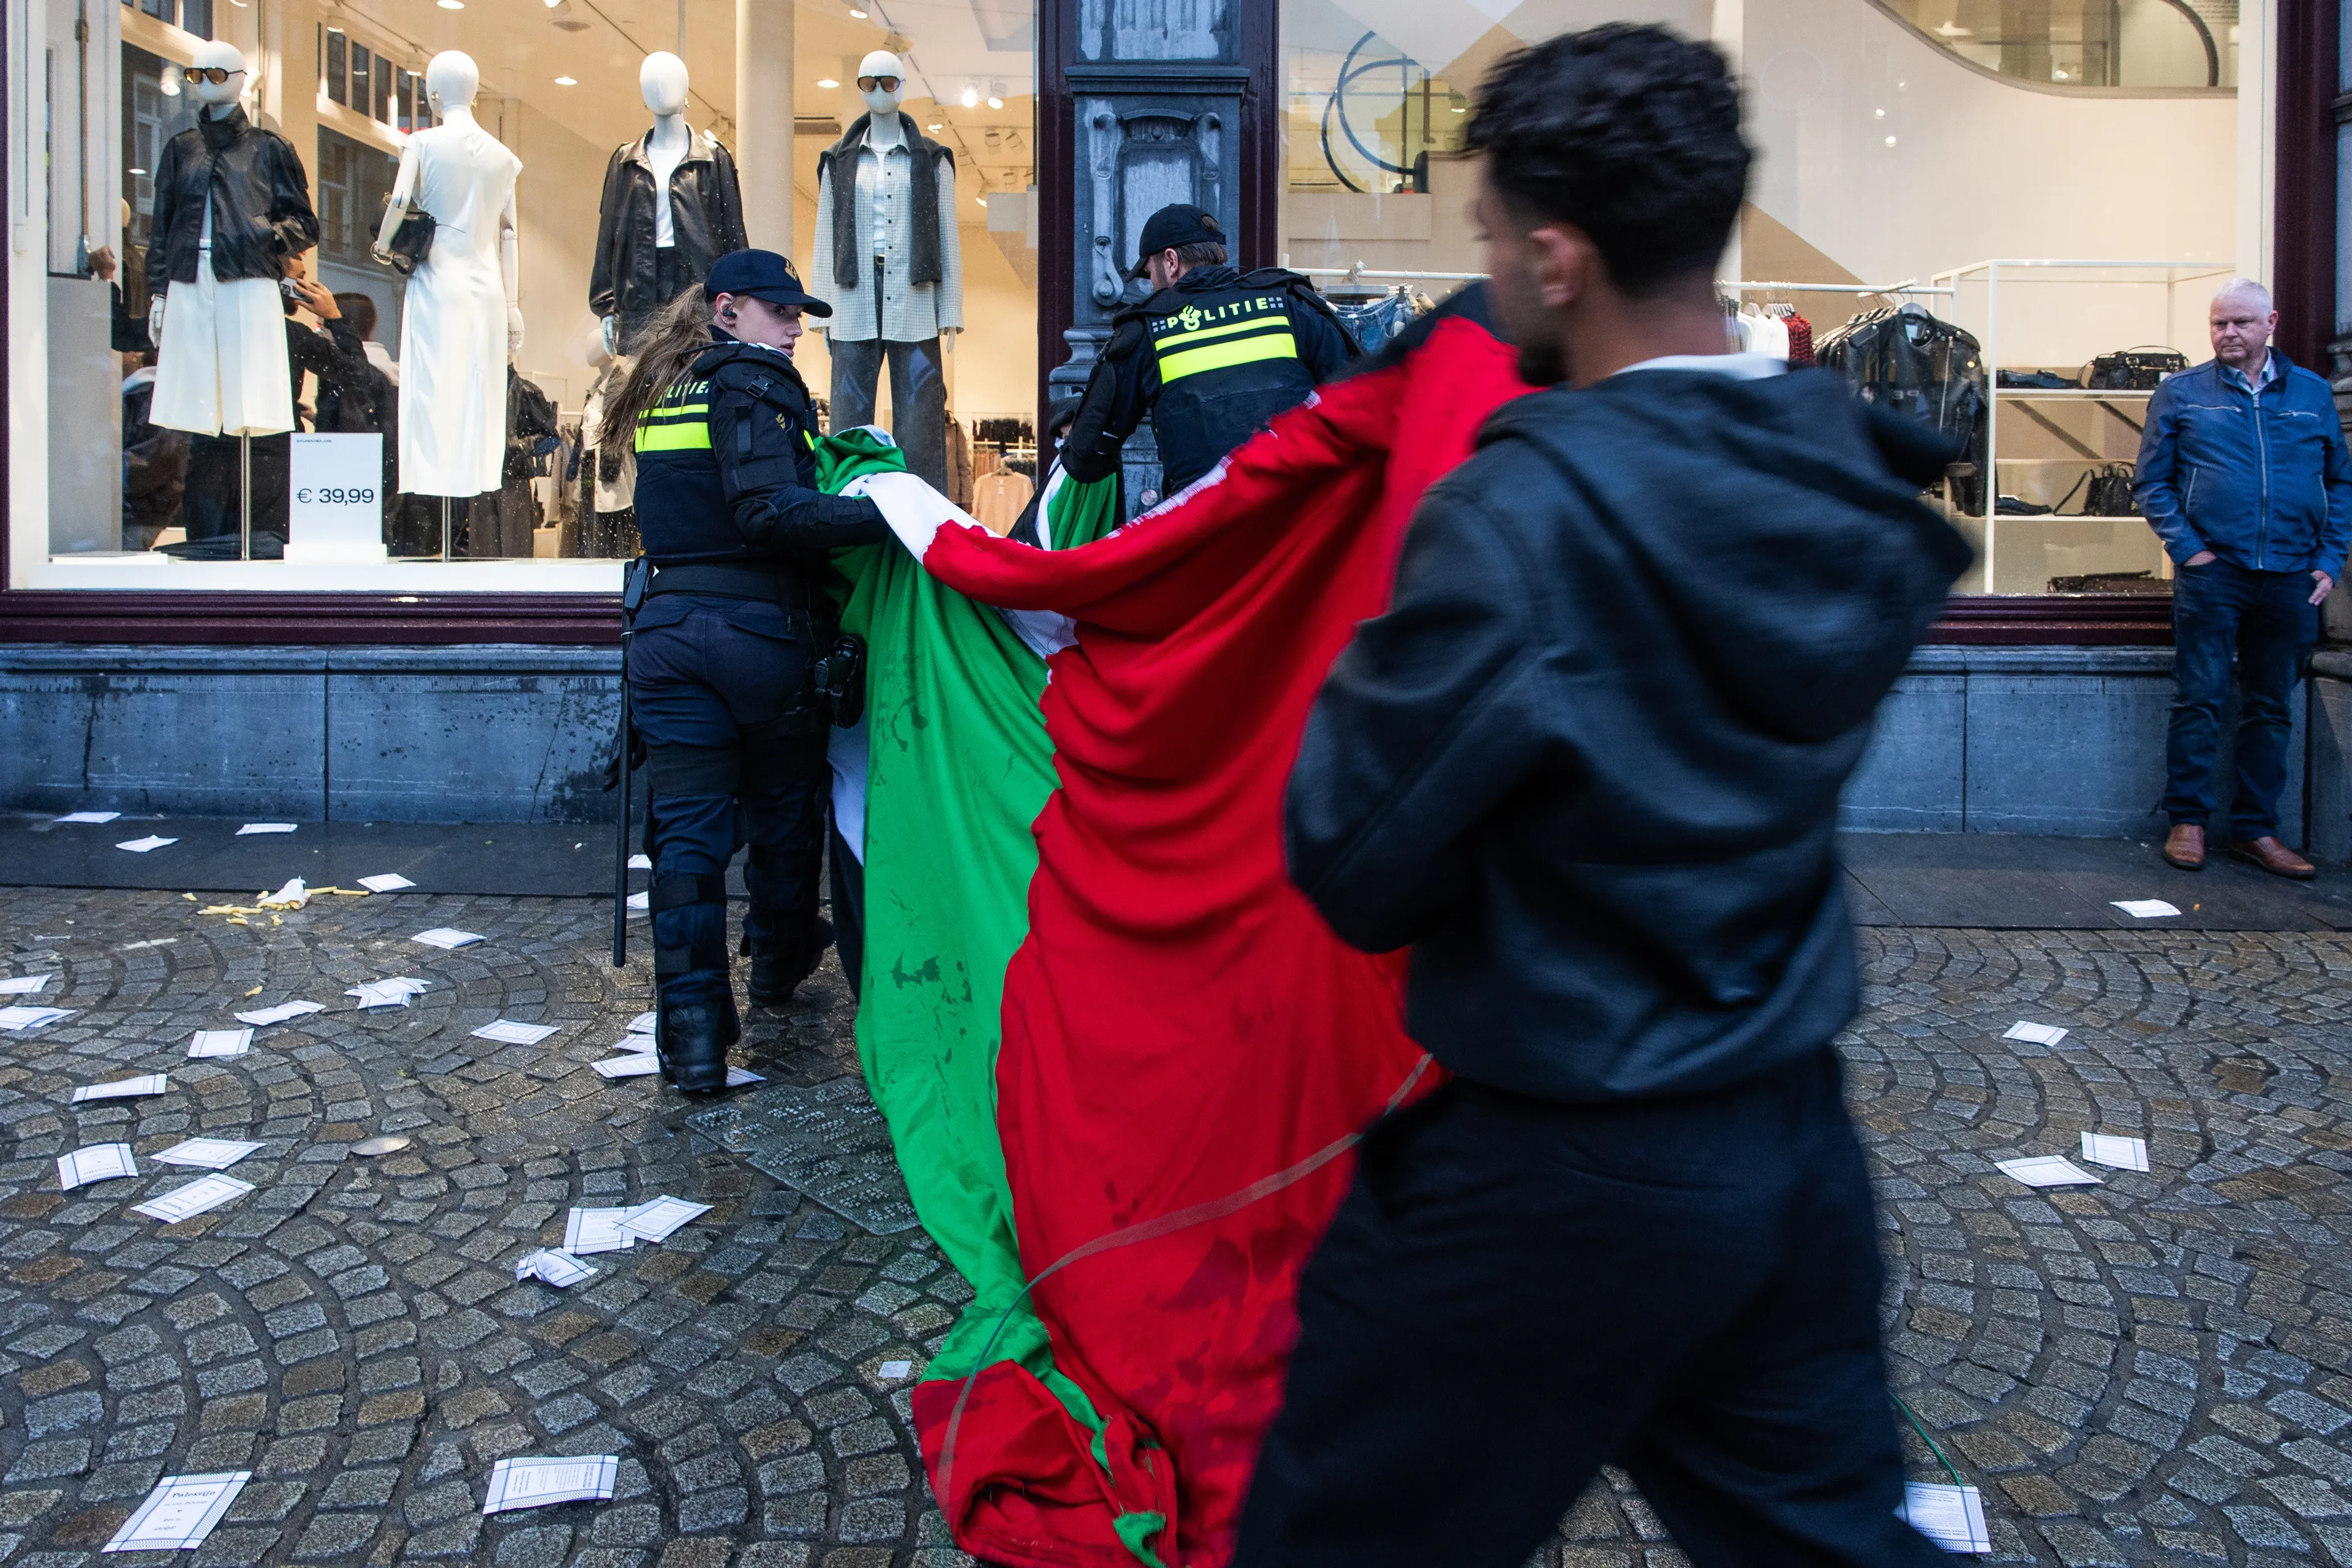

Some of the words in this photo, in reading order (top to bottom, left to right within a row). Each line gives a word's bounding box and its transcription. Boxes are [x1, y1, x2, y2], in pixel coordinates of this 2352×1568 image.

[1167, 297, 1268, 331] POLITIE
[655, 381, 709, 406] LITIE
[296, 488, 312, 503] €
[319, 488, 374, 505] 39,99
